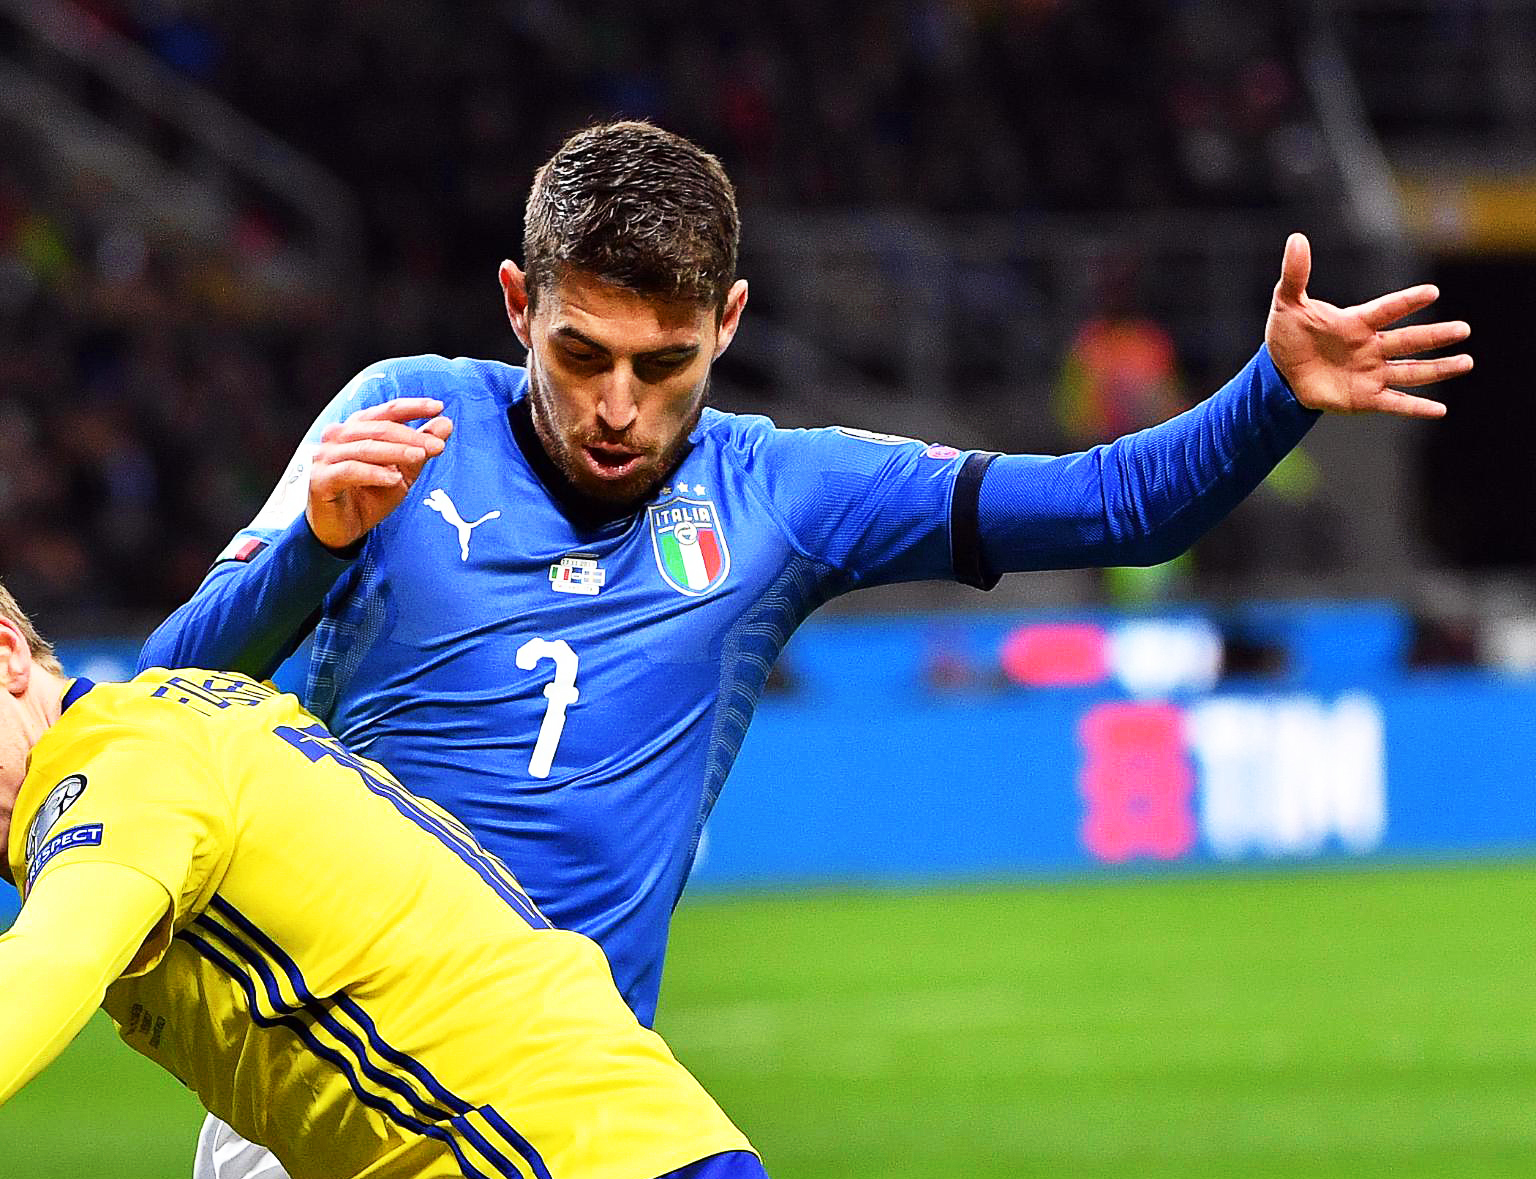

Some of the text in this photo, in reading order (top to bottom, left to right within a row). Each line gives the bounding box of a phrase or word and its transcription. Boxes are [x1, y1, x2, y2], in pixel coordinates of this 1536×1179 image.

[655, 507, 711, 527] ITALIA
[515, 636, 580, 779] 7
[29, 827, 102, 883] RESPECT
